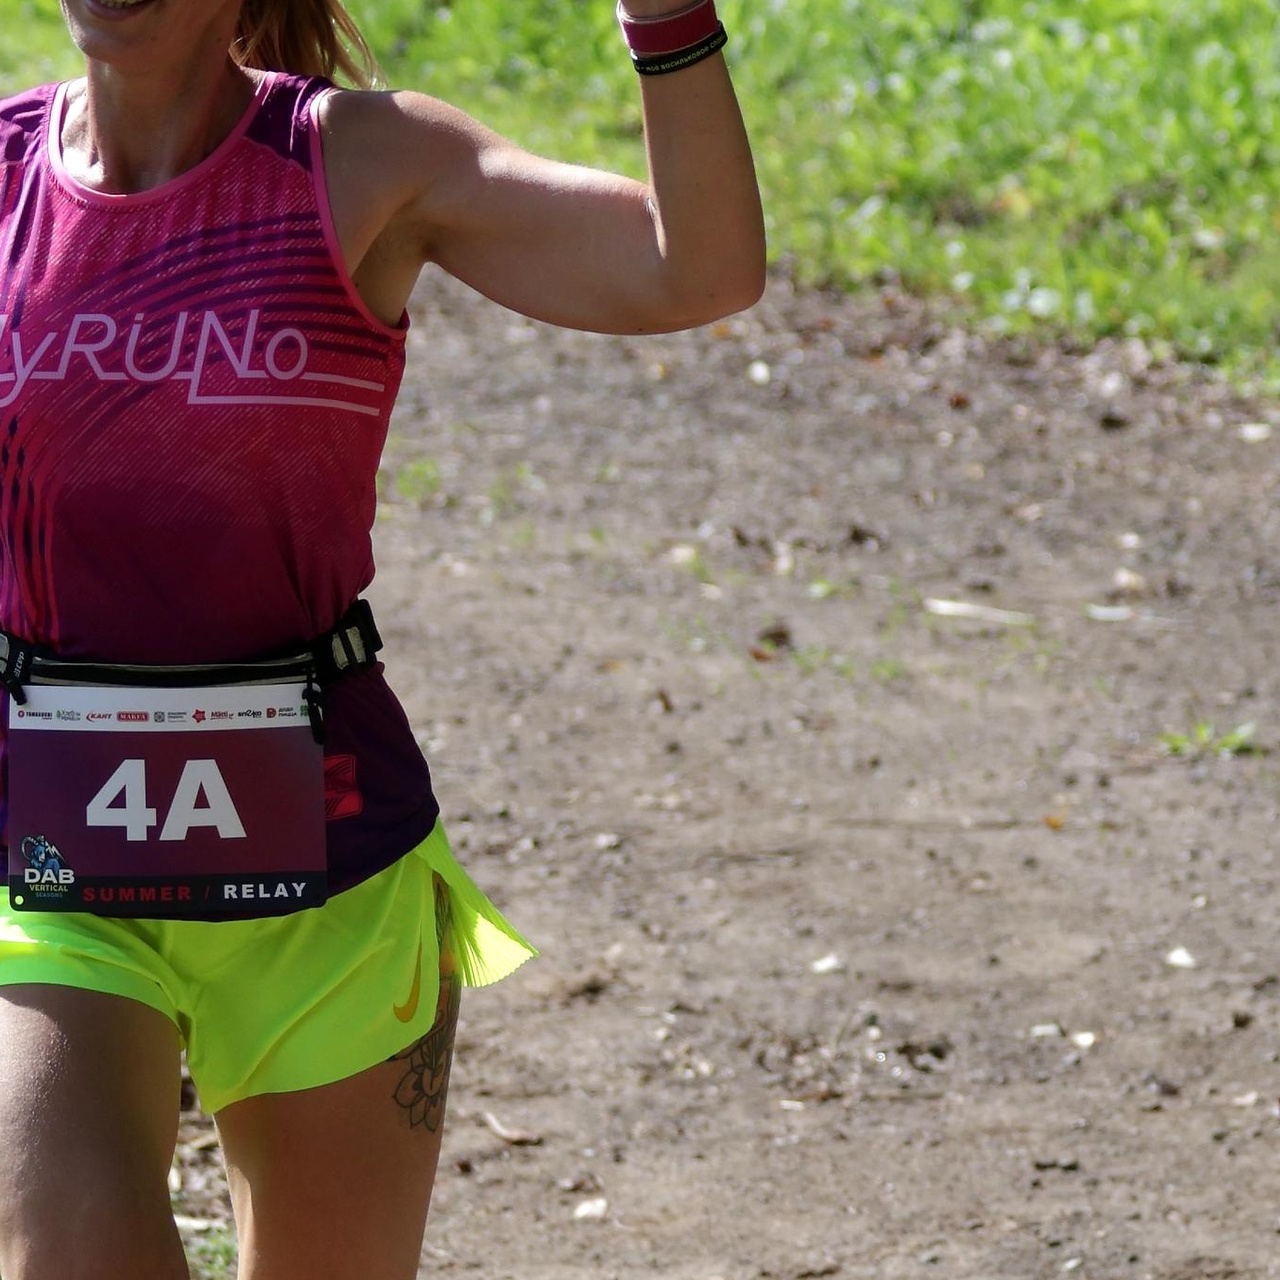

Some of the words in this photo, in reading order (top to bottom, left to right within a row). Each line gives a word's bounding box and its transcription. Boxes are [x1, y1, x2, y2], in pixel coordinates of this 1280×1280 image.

[86, 758, 248, 842] 4A
[24, 868, 75, 884] DAB
[29, 884, 68, 892] VERTICAL
[83, 886, 192, 902] SUMMER
[223, 882, 307, 900] RELAY
